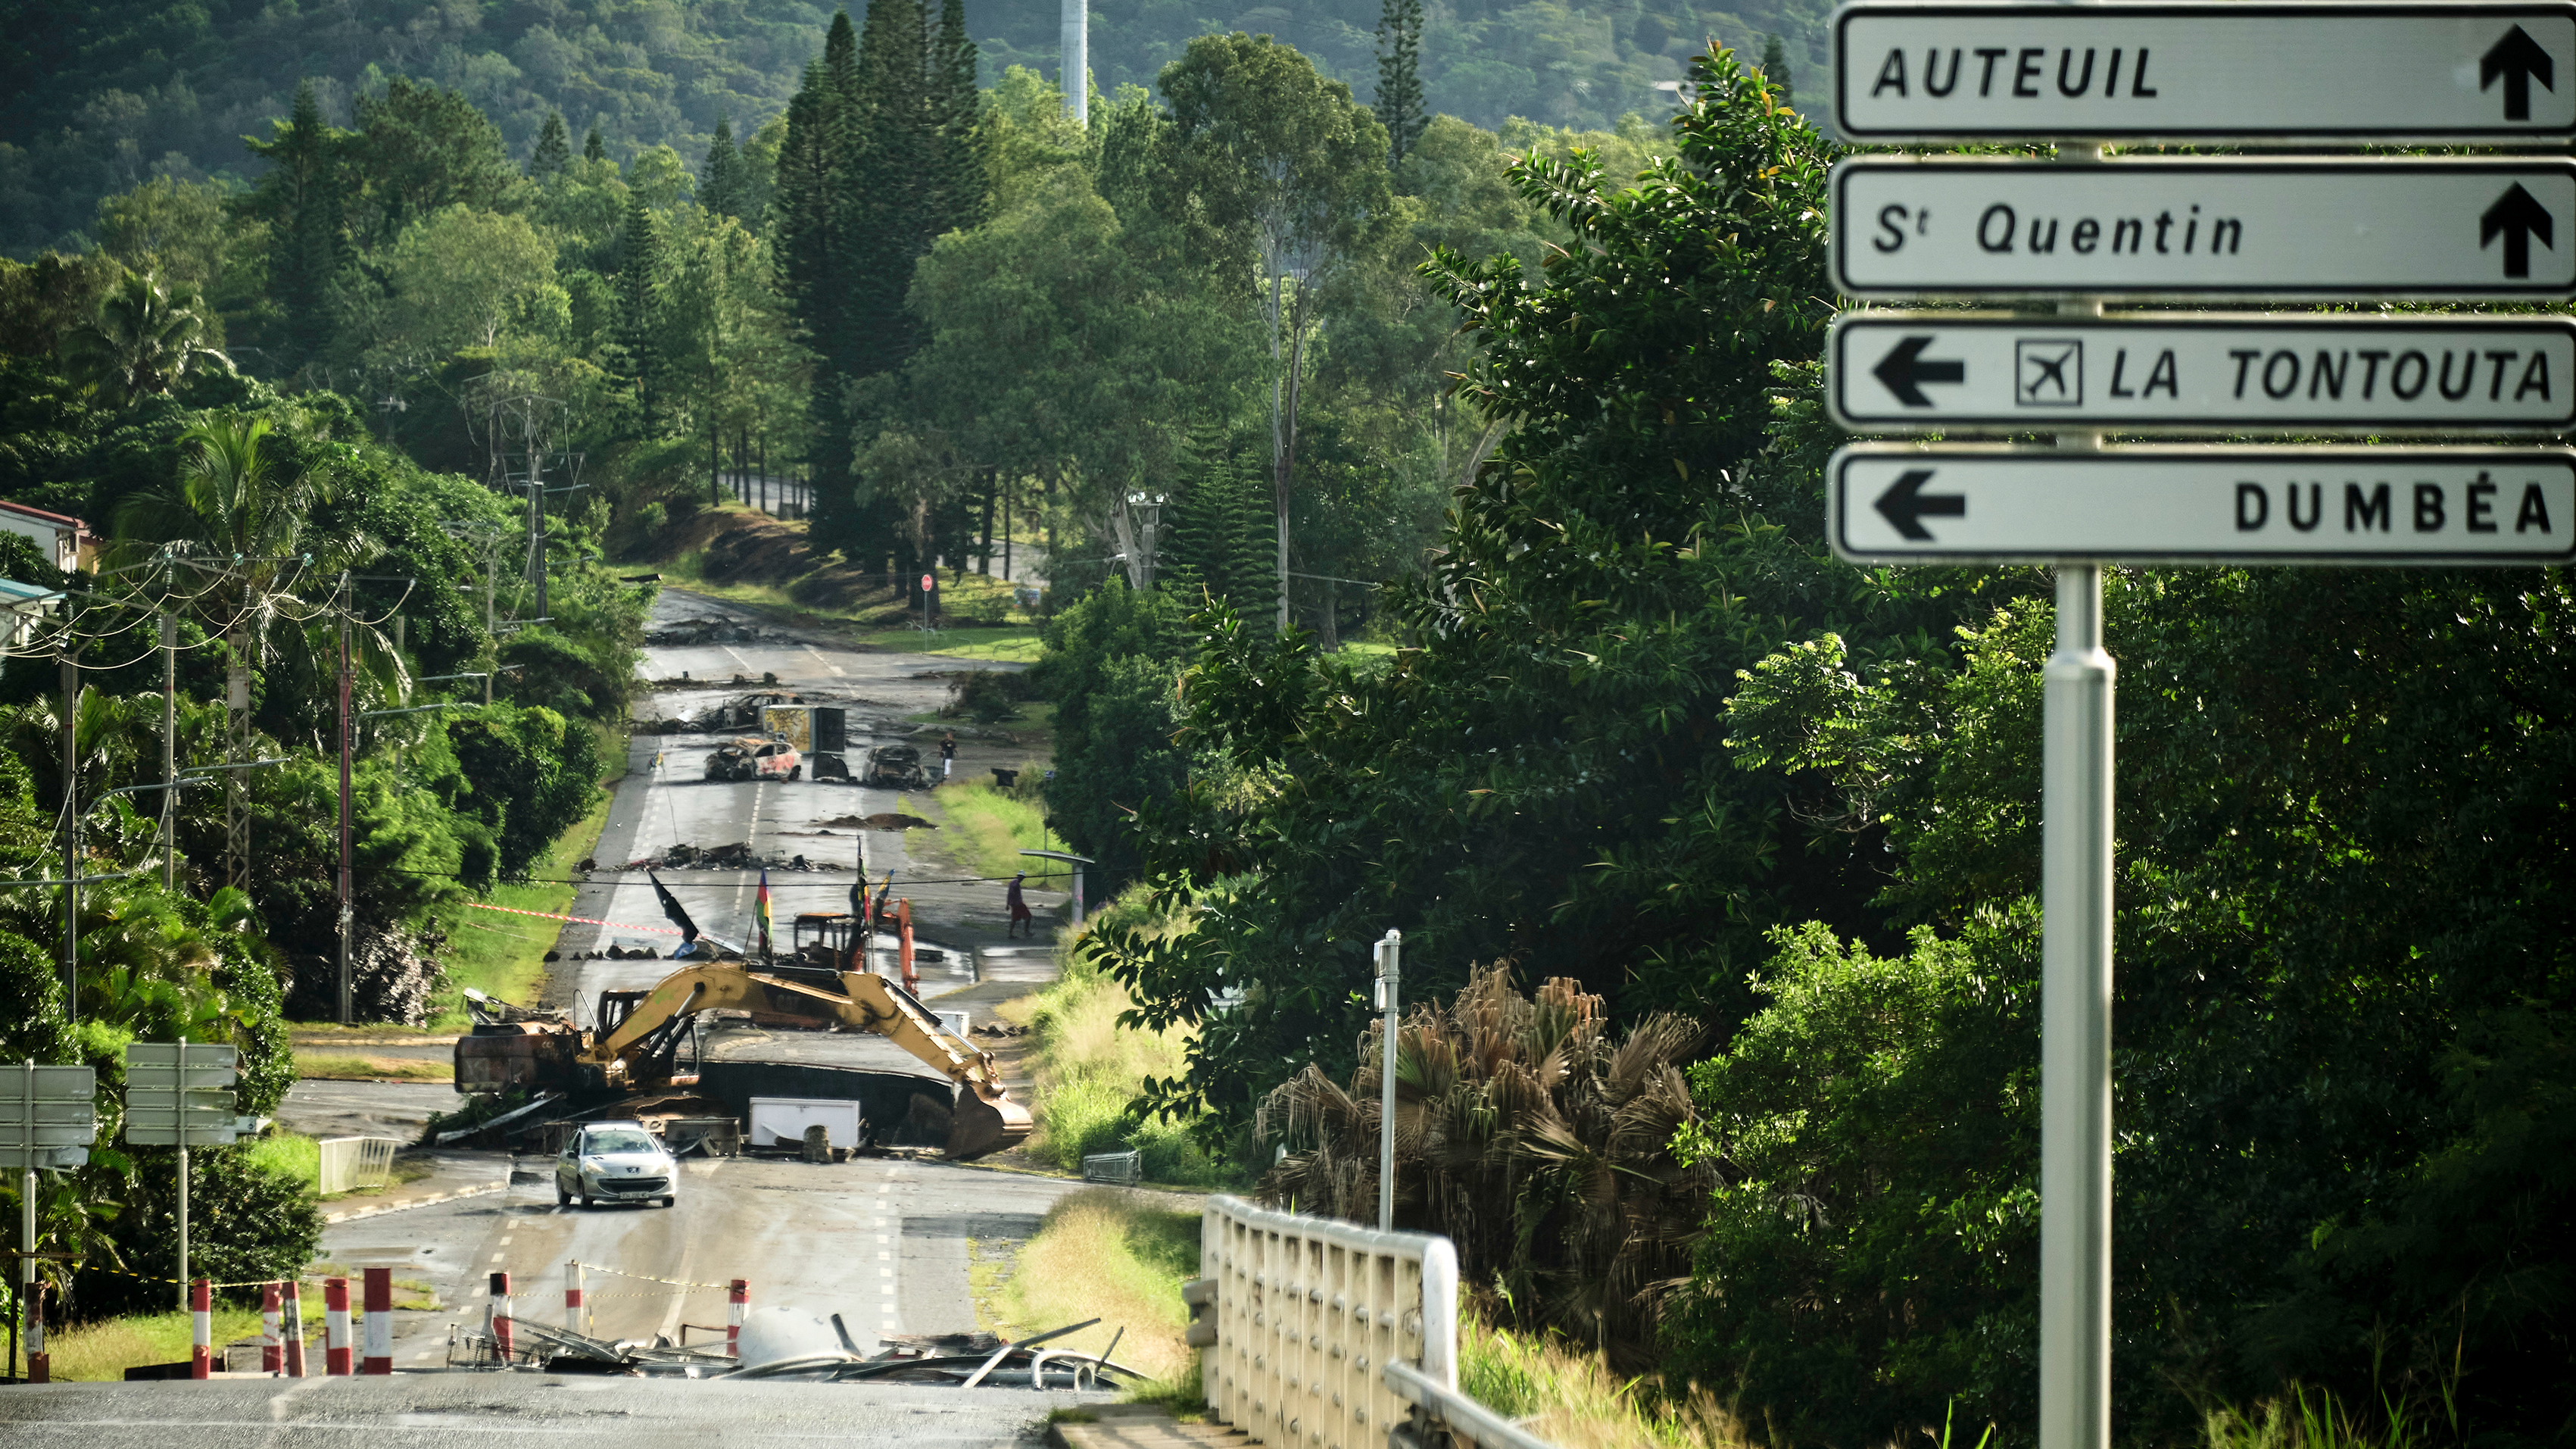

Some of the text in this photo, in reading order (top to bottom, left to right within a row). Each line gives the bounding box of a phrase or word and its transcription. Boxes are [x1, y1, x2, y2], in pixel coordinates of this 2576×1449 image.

[1872, 48, 2158, 98] AUTEUIL
[1873, 204, 2243, 255] St Quentin
[2110, 350, 2552, 401] LA TONTOUTA
[2235, 473, 2552, 533] DUMBÉA
